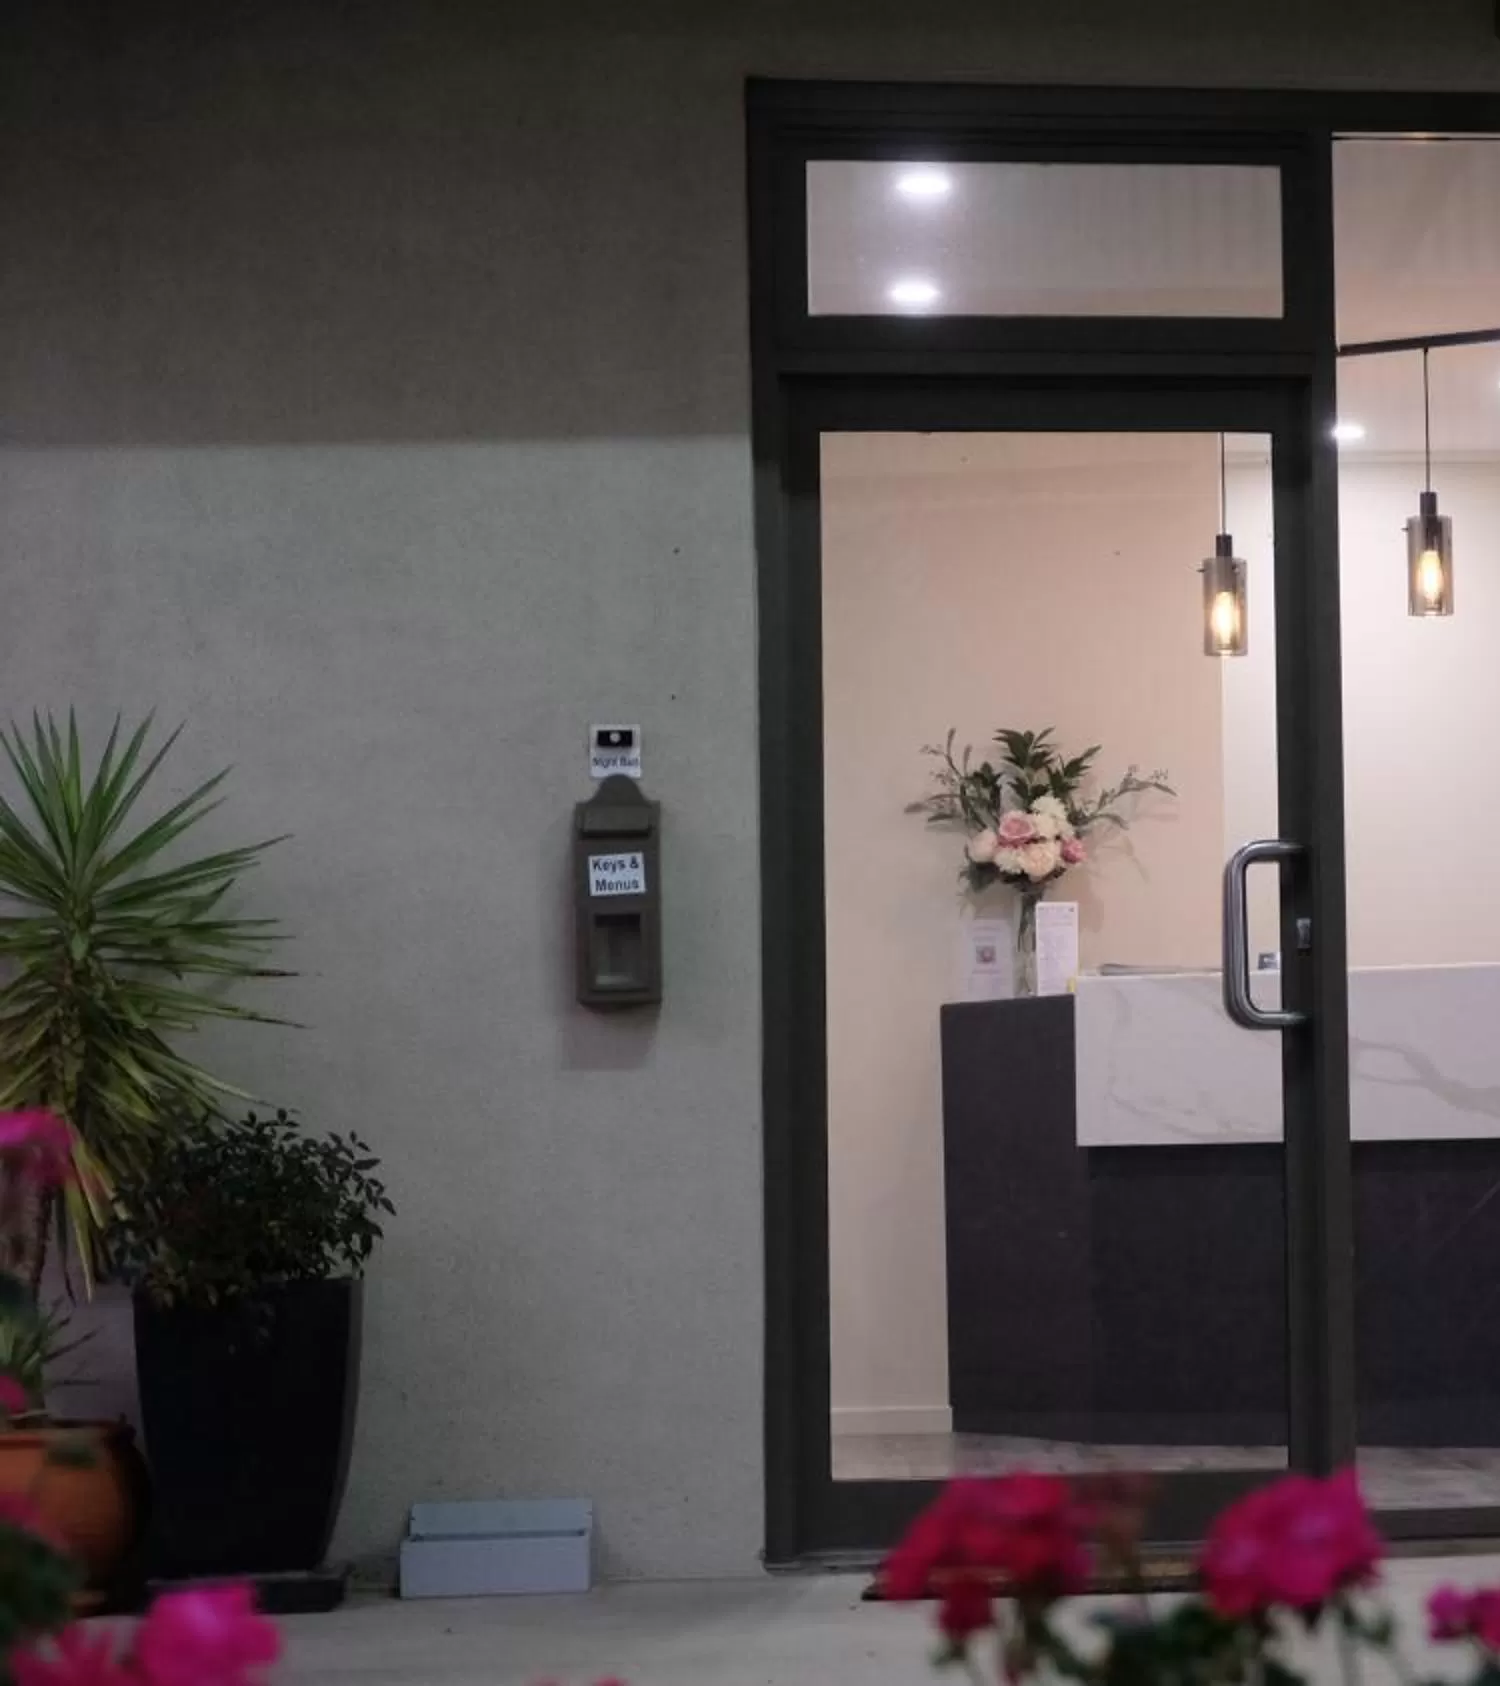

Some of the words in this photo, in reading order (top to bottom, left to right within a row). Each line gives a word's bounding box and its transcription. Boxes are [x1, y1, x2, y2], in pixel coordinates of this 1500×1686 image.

[592, 858, 626, 873] Keys
[629, 855, 640, 869] &
[595, 878, 640, 892] Menus
